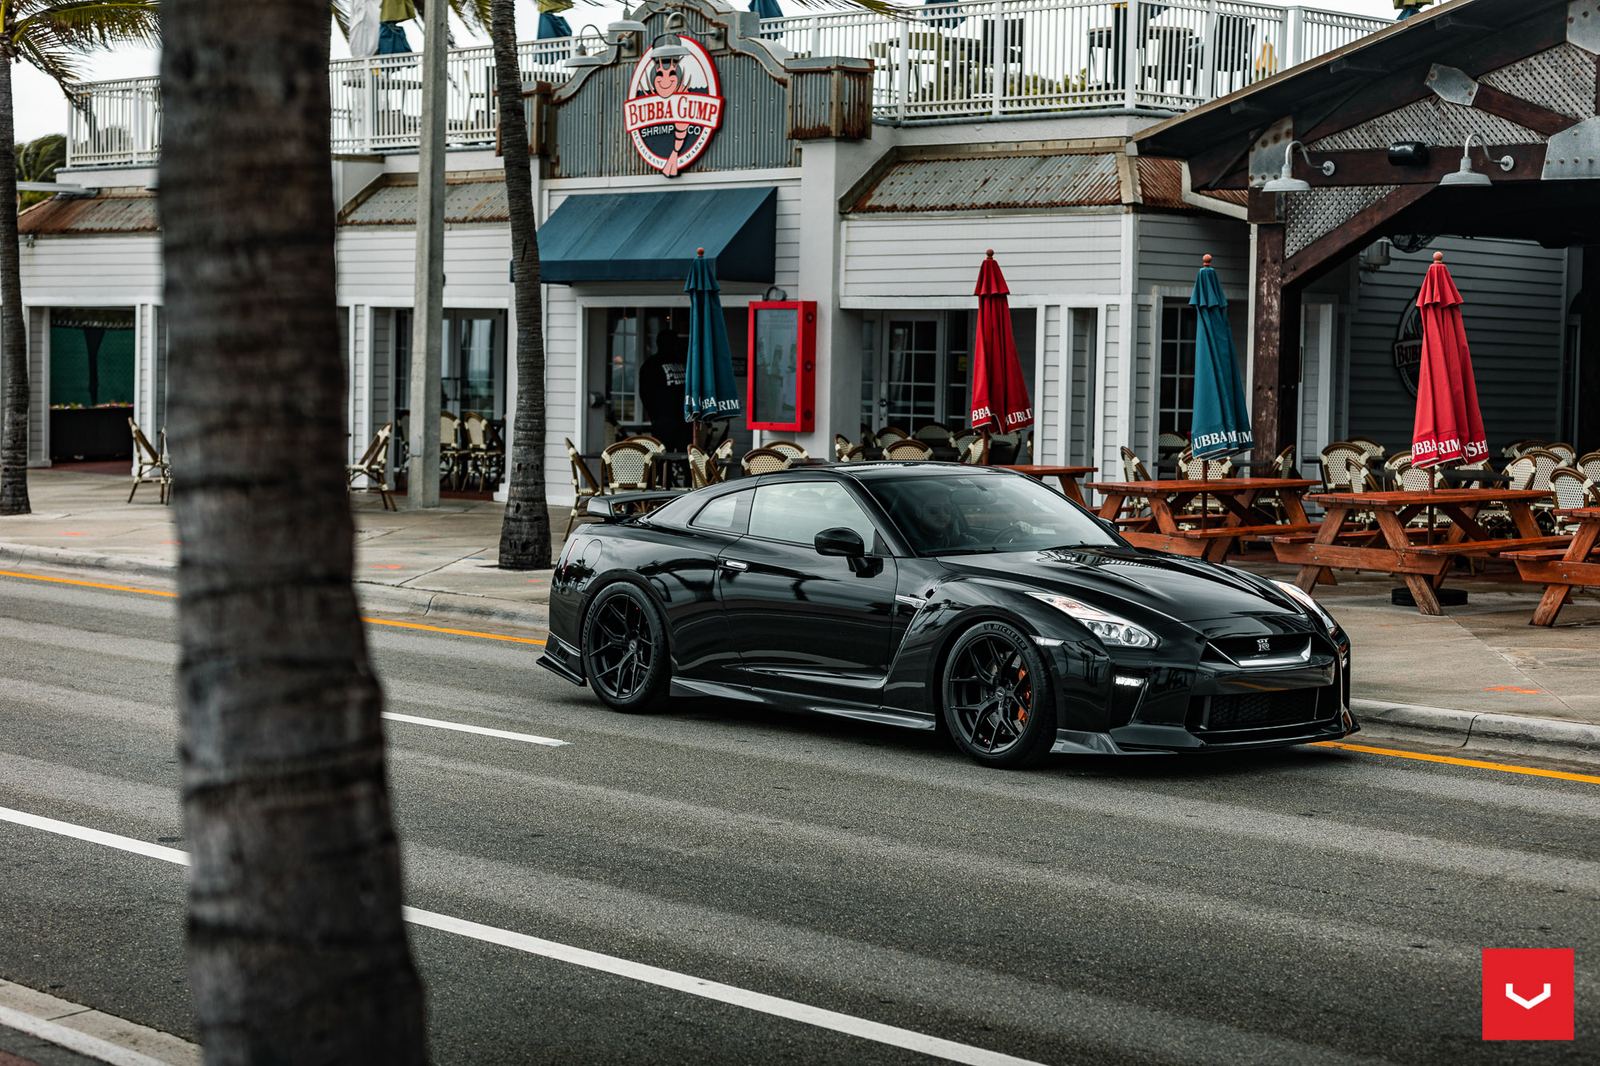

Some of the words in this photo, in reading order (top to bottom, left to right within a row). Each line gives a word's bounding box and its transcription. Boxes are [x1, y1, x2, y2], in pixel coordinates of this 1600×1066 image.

[628, 99, 674, 126] BUBBA
[677, 96, 718, 122] GUMP
[641, 125, 675, 138] SHRIMP
[687, 125, 701, 136] CO
